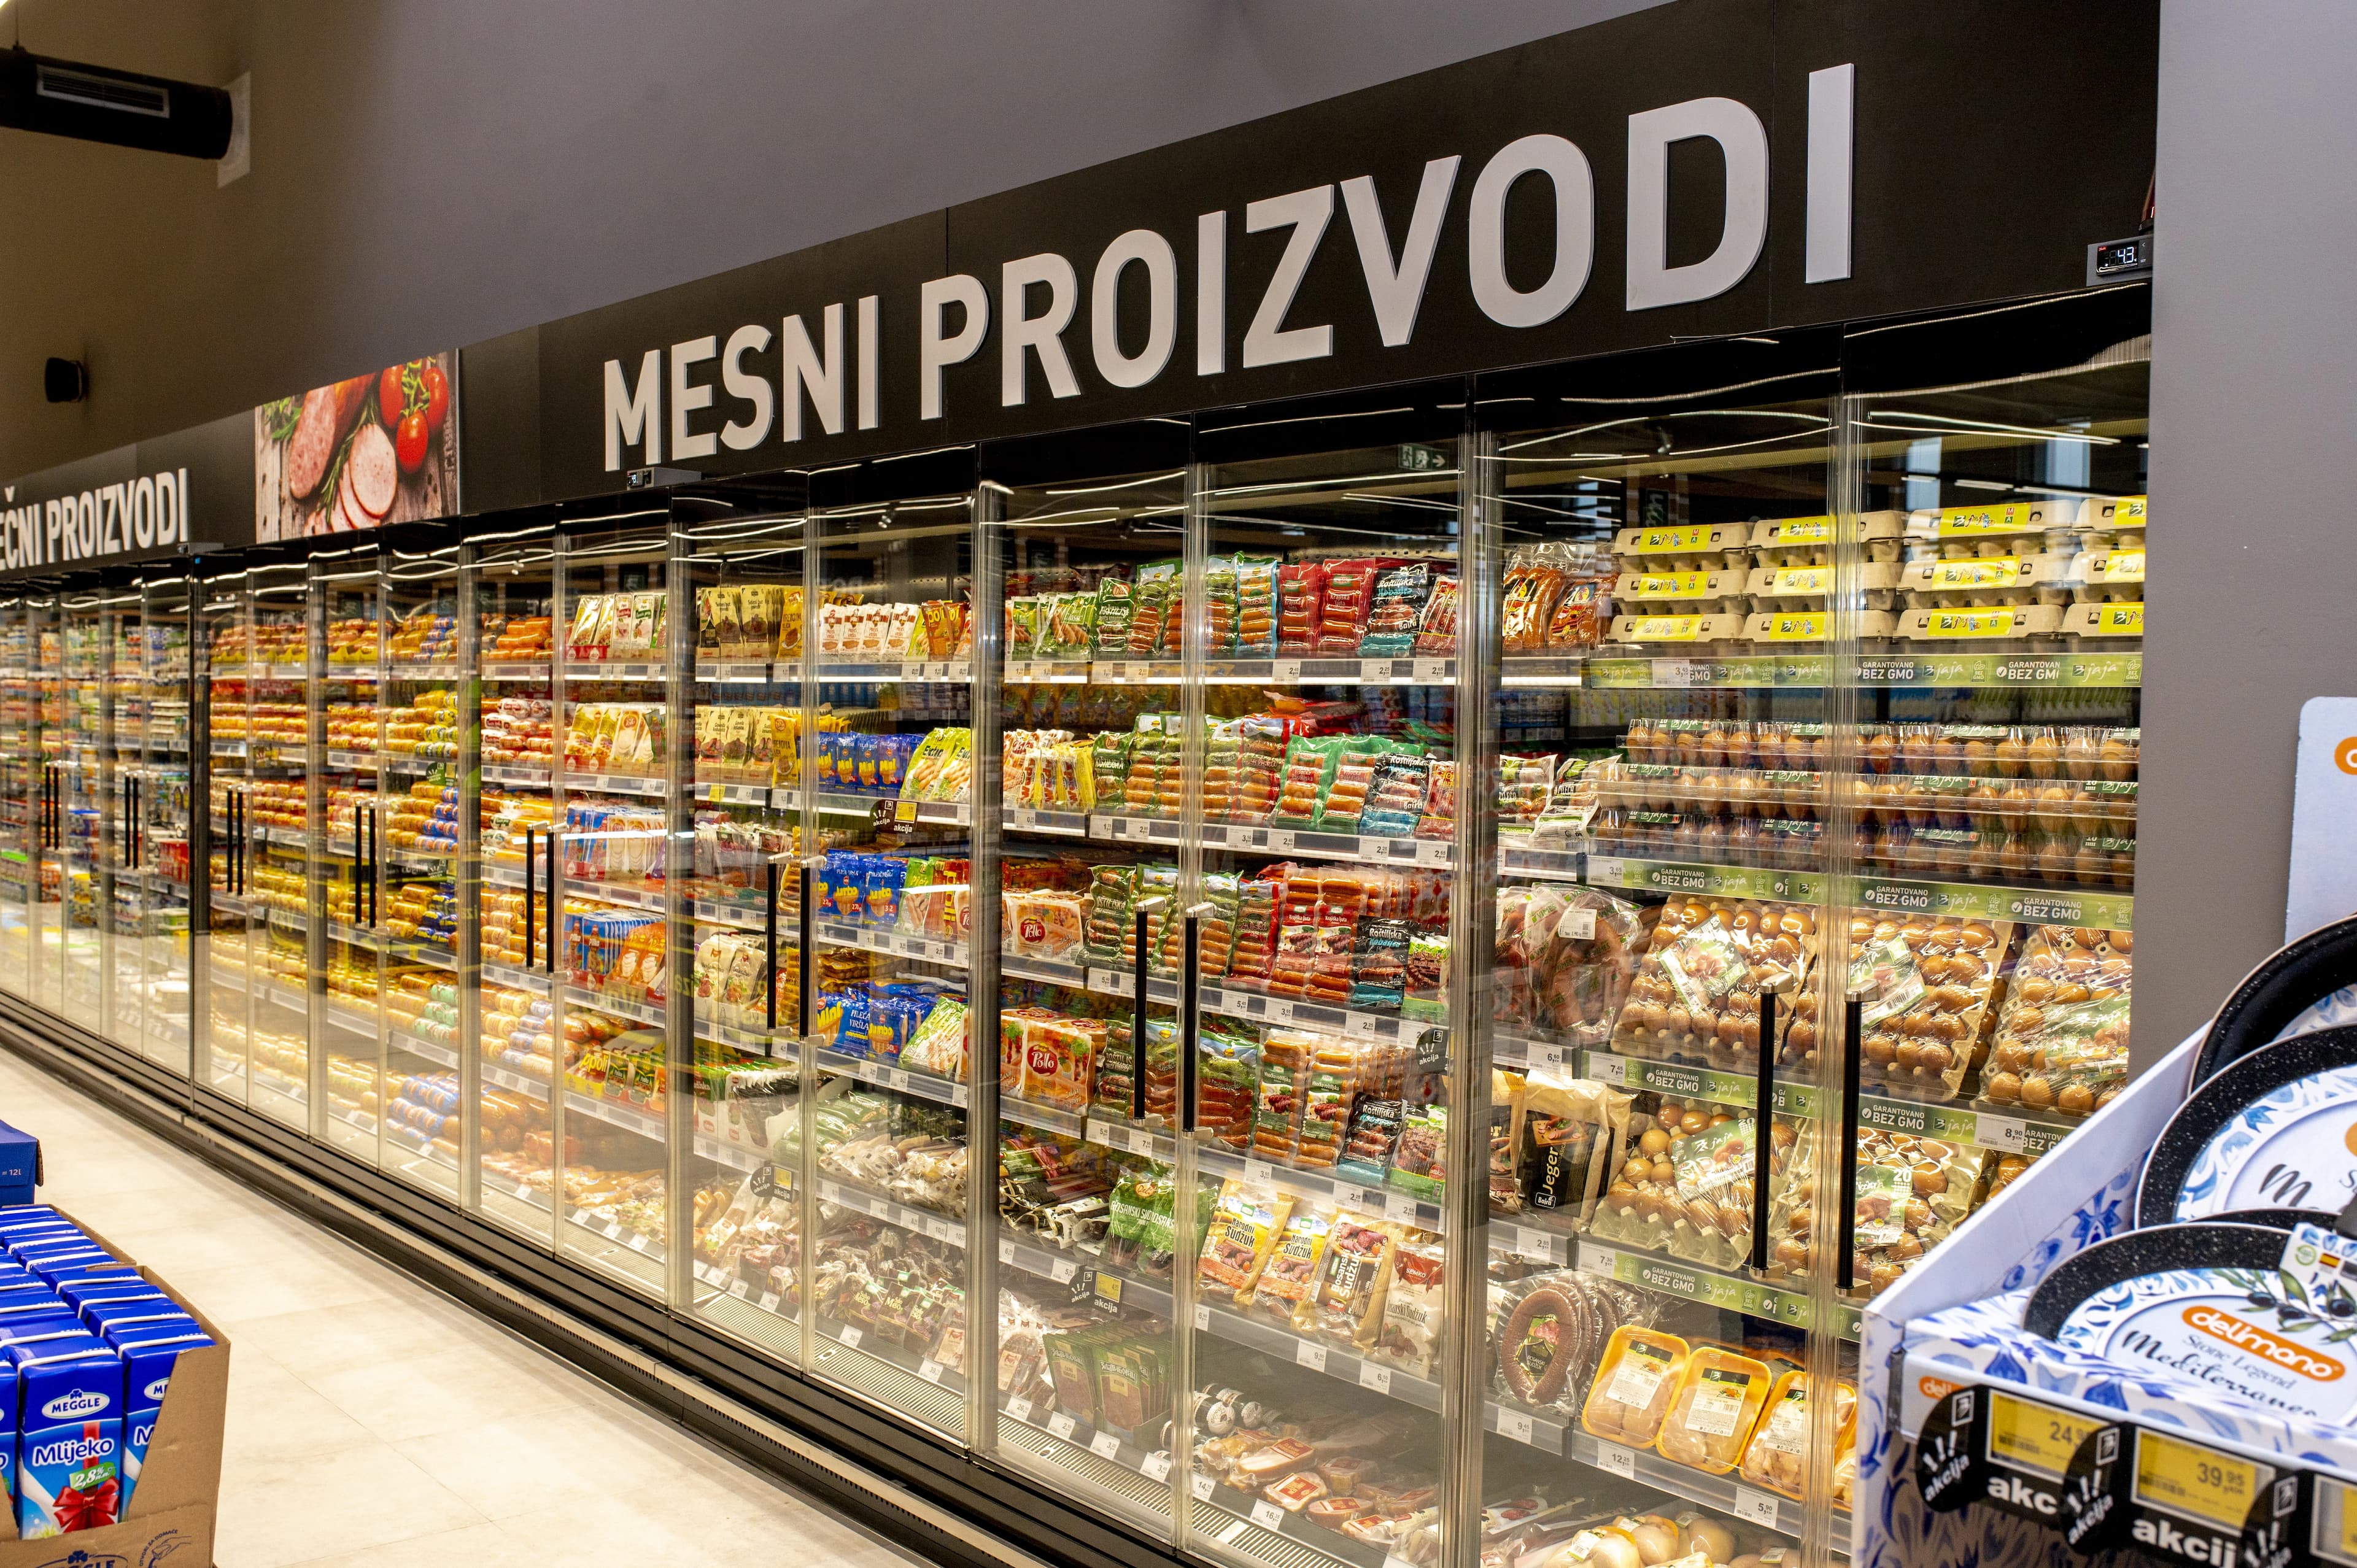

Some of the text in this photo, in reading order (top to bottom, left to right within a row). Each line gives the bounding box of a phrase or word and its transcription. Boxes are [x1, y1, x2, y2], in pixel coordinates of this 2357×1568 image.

[604, 63, 1856, 473] MESNI PROIZVODI
[47, 468, 188, 564] PROIZVODI
[1728, 664, 1754, 682] jaja
[1795, 662, 1822, 681] jaja
[1862, 668, 1914, 680] BEZ GMO
[1934, 662, 1964, 682] jaja
[2008, 668, 2029, 679] BEZ
[2085, 662, 2117, 682] jaja
[873, 817, 890, 827] akcija
[893, 824, 913, 834] akcija
[1661, 868, 1705, 878] GARANTOVANO
[1662, 875, 1705, 888] BEZ GMO
[1720, 875, 1747, 892] jaja
[1876, 886, 1929, 897] GARANTOVANO
[1876, 894, 1929, 908] BEZ GMO
[1947, 893, 1978, 912] jaja
[2024, 898, 2082, 910] GARANTOVANO
[2023, 905, 2081, 921] BEZ GMO
[1369, 927, 1402, 940] Roštiljska
[1032, 1051, 1055, 1069] Pollo
[1418, 1053, 1439, 1065] akcija
[1610, 1065, 1624, 1075] 7,45
[1655, 1070, 1699, 1082] GARANTOVANO
[1655, 1076, 1699, 1092] BEZ GMO
[1715, 1081, 1741, 1098] jaja
[1362, 1105, 1395, 1119] Roštiljska
[1873, 1105, 1925, 1119] GARANTOVANO
[1738, 1116, 1755, 1126] 20
[1872, 1112, 1925, 1130] BEZ GMO
[1945, 1115, 1975, 1137] jaja
[2005, 1127, 2023, 1140] 8,90
[1542, 1146, 1559, 1194] Jeger
[1894, 1168, 1913, 1183] 20
[753, 1182, 770, 1194] akcija
[774, 1188, 791, 1199] akcija
[1232, 1217, 1255, 1234] Narodni
[1225, 1225, 1255, 1247] Sudžuk
[1291, 1234, 1312, 1246] Narodni
[1283, 1242, 1312, 1259] Sudžuk
[1600, 1255, 1613, 1265] 7,30
[1331, 1248, 1350, 1292] Bosanski
[1339, 1250, 1361, 1298] Sudžuk
[1406, 1268, 1426, 1278] SEMKO
[1652, 1267, 1695, 1282] GARANTOVANO
[1651, 1275, 1695, 1293] BEZ GMO
[1709, 1281, 1736, 1302] jaja
[1071, 1290, 1090, 1303] akcija
[1329, 1299, 1344, 1308] Blago
[1094, 1299, 1118, 1313] akcija
[1406, 1305, 1428, 1324] Sudžuk
[2191, 1308, 2332, 1378] delimano
[1377, 1373, 1389, 1383] 6,10
[1922, 1381, 1952, 1398] deli
[1925, 1454, 1970, 1502] akcija
[1987, 1477, 2057, 1515] akc
[1757, 1500, 1773, 1513] 5,90
[1265, 1510, 1280, 1521] 16,35
[2068, 1495, 2113, 1545] akcija
[2132, 1518, 2237, 1568] akcij
